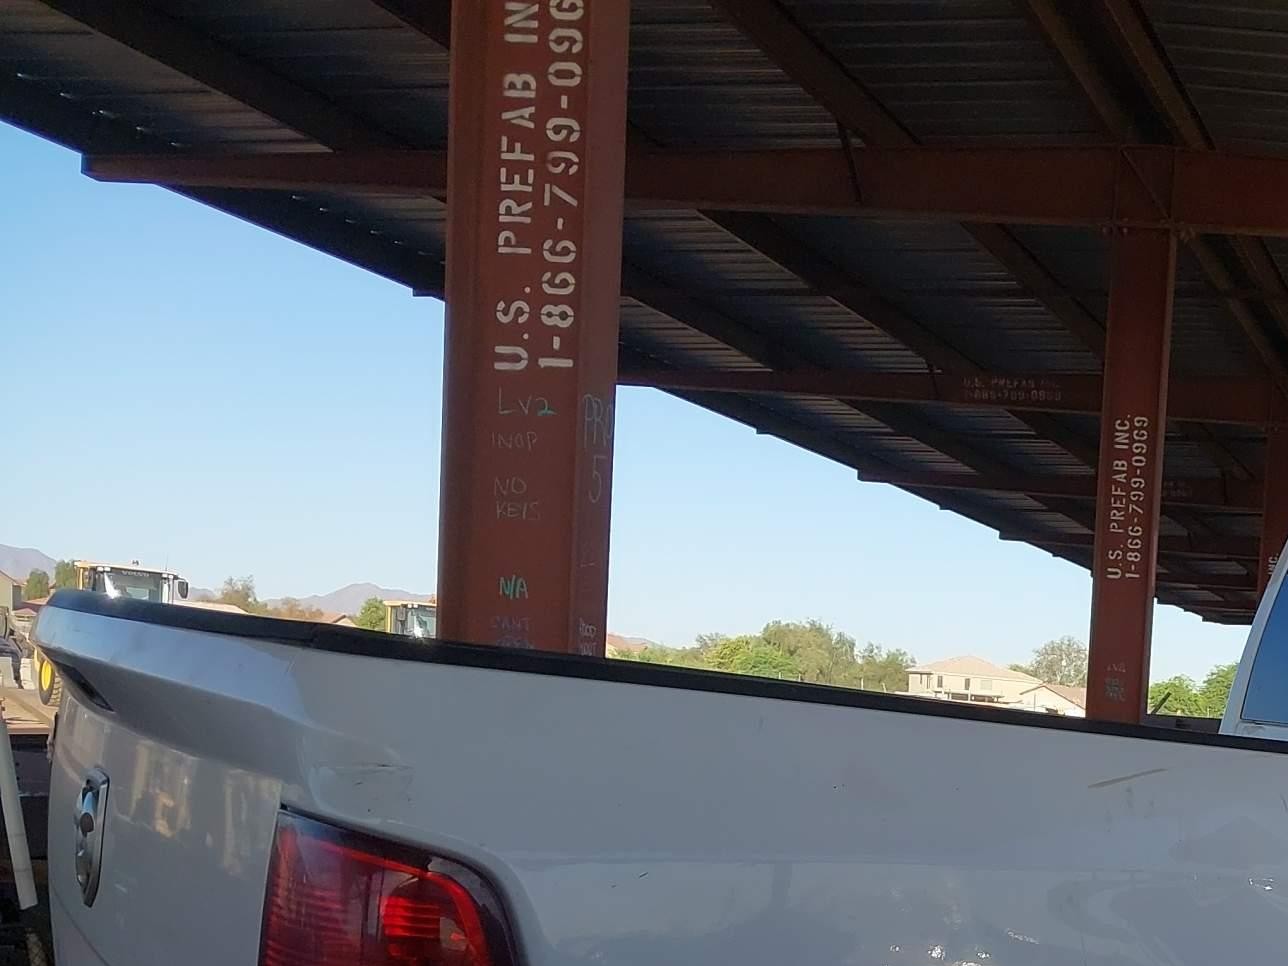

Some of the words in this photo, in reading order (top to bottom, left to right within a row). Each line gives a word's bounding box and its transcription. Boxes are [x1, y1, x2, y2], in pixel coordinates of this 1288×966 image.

[497, 73, 537, 254] PREFAB
[494, 286, 531, 370] U.S.
[1113, 414, 1131, 449] INC.
[1109, 459, 1128, 533] PREFAB
[1125, 416, 1149, 578] 1-866-799-0969
[499, 575, 529, 599] N/A
[1106, 545, 1124, 579] U.S.
